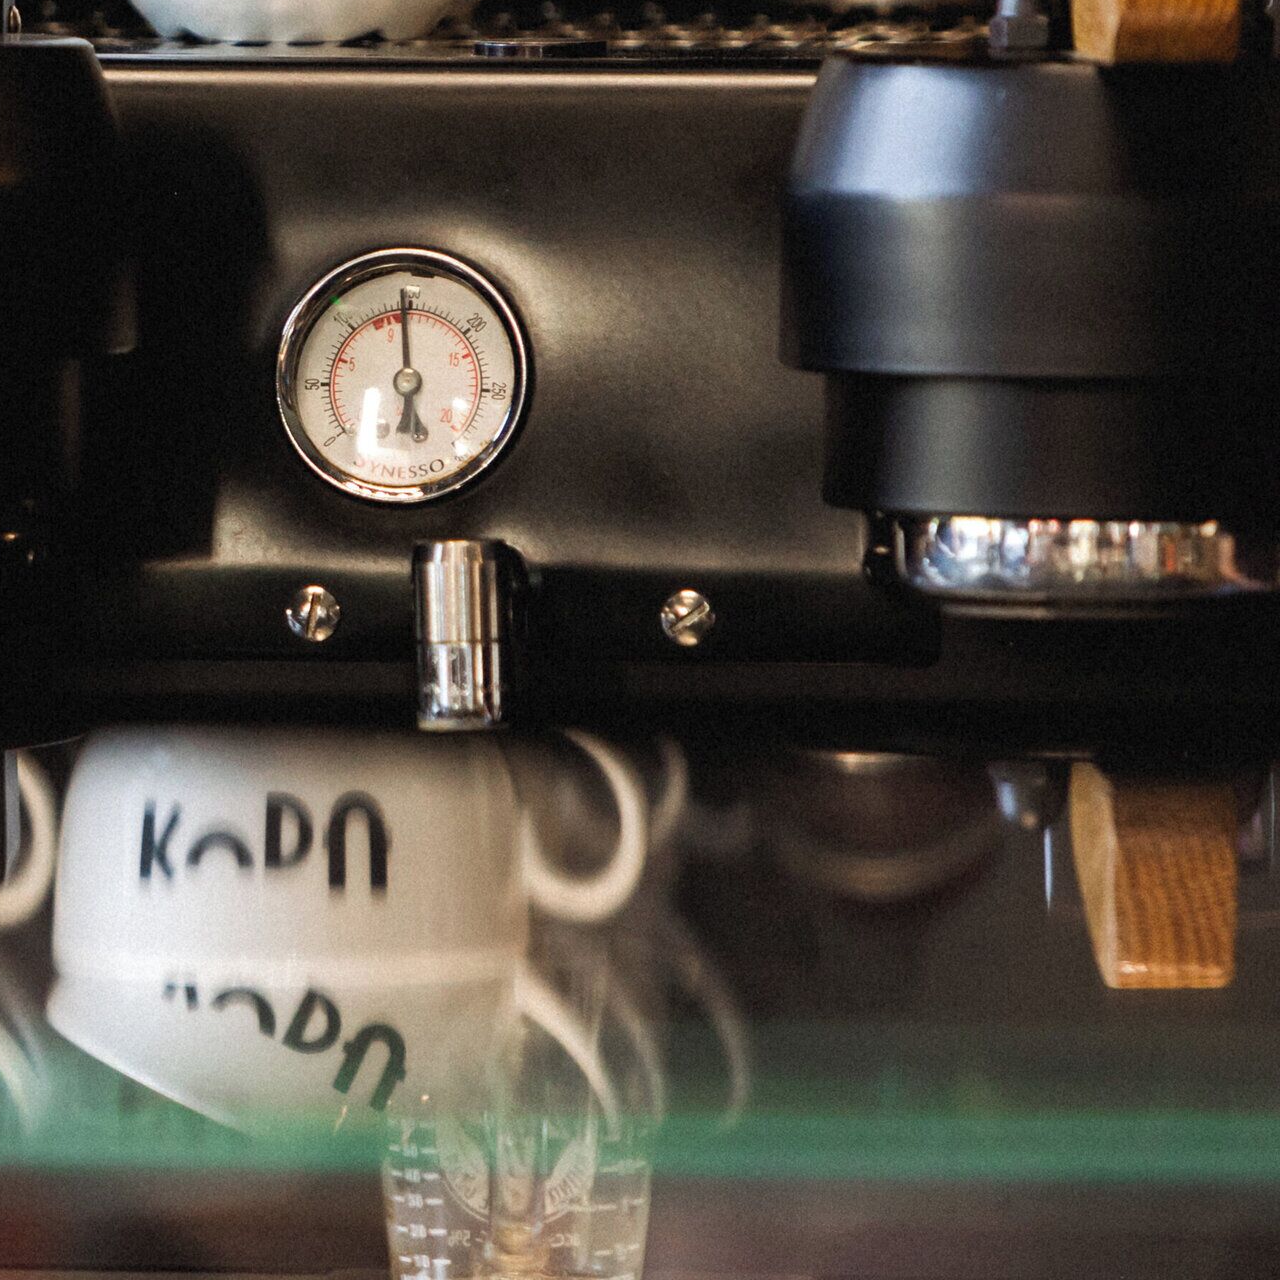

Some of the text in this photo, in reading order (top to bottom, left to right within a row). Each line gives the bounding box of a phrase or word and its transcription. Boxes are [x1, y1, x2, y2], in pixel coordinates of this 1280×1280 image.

[467, 312, 488, 333] 200
[449, 352, 460, 368] 15
[304, 378, 320, 391] 50
[491, 382, 507, 401] 250
[440, 408, 453, 423] 20
